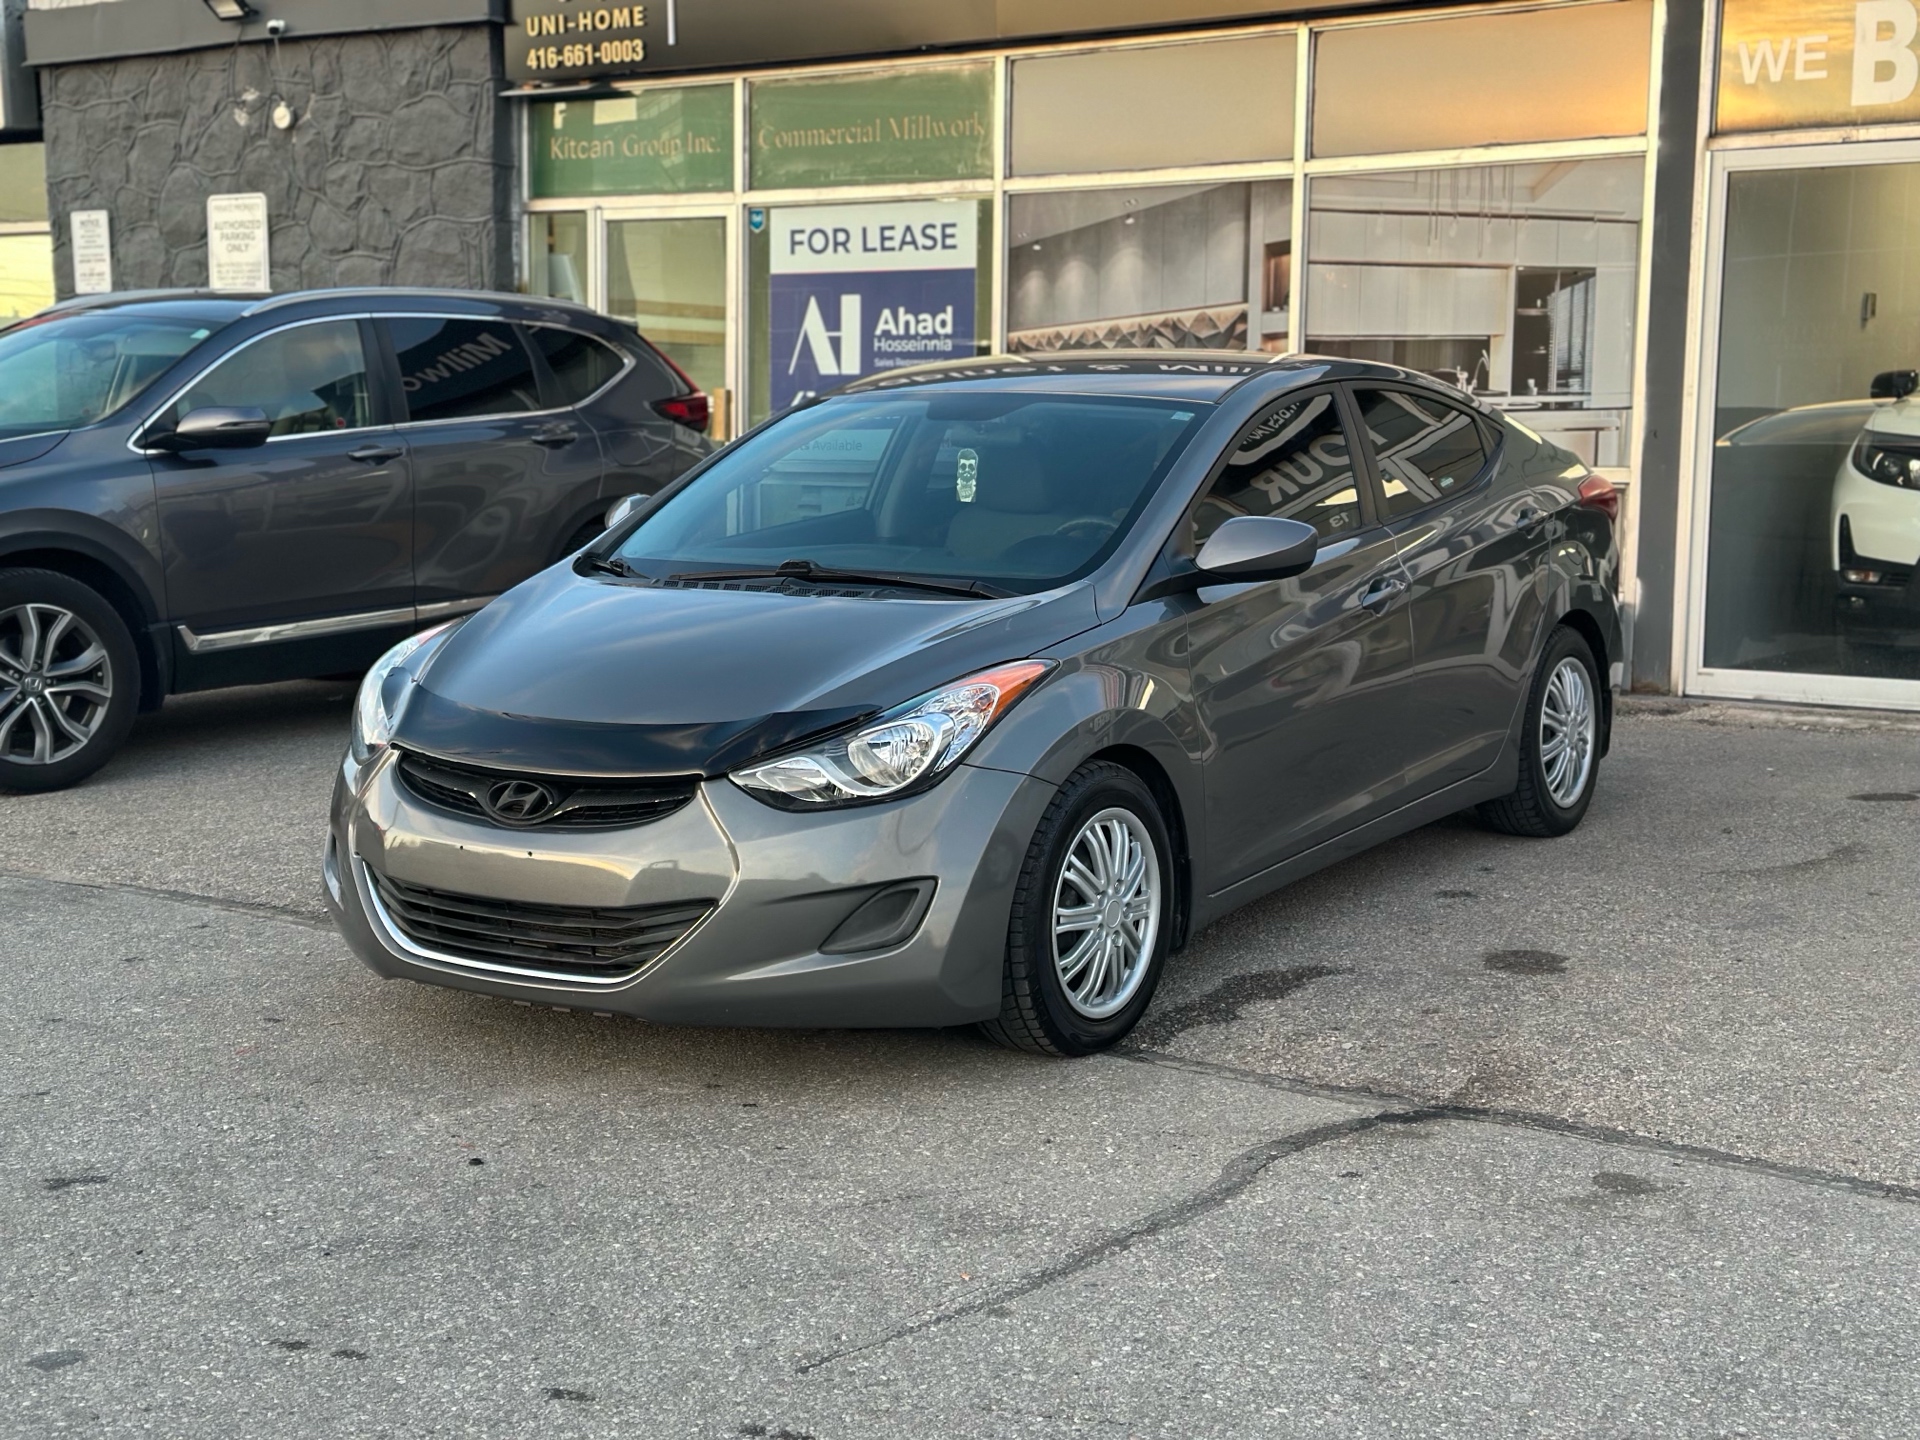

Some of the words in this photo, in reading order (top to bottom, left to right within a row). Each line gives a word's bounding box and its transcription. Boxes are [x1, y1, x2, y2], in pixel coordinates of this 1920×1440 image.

[526, 5, 645, 37] UNI-HOME
[526, 38, 644, 71] 416-661-0003
[1738, 35, 1829, 85] WE
[1851, 0, 1919, 107] B
[551, 136, 615, 160] Kitcan
[622, 133, 682, 157] Group
[687, 131, 721, 154] Inc.
[758, 118, 881, 150] Commercial
[889, 112, 985, 141] Millwork
[214, 219, 262, 231] AUTHORIZED
[219, 230, 256, 242] PARKING
[789, 227, 851, 255] FOR
[862, 222, 958, 253] LEASE
[226, 242, 250, 254] ONLY
[874, 305, 954, 337] Ahad
[873, 335, 953, 353] Hosseinnia
